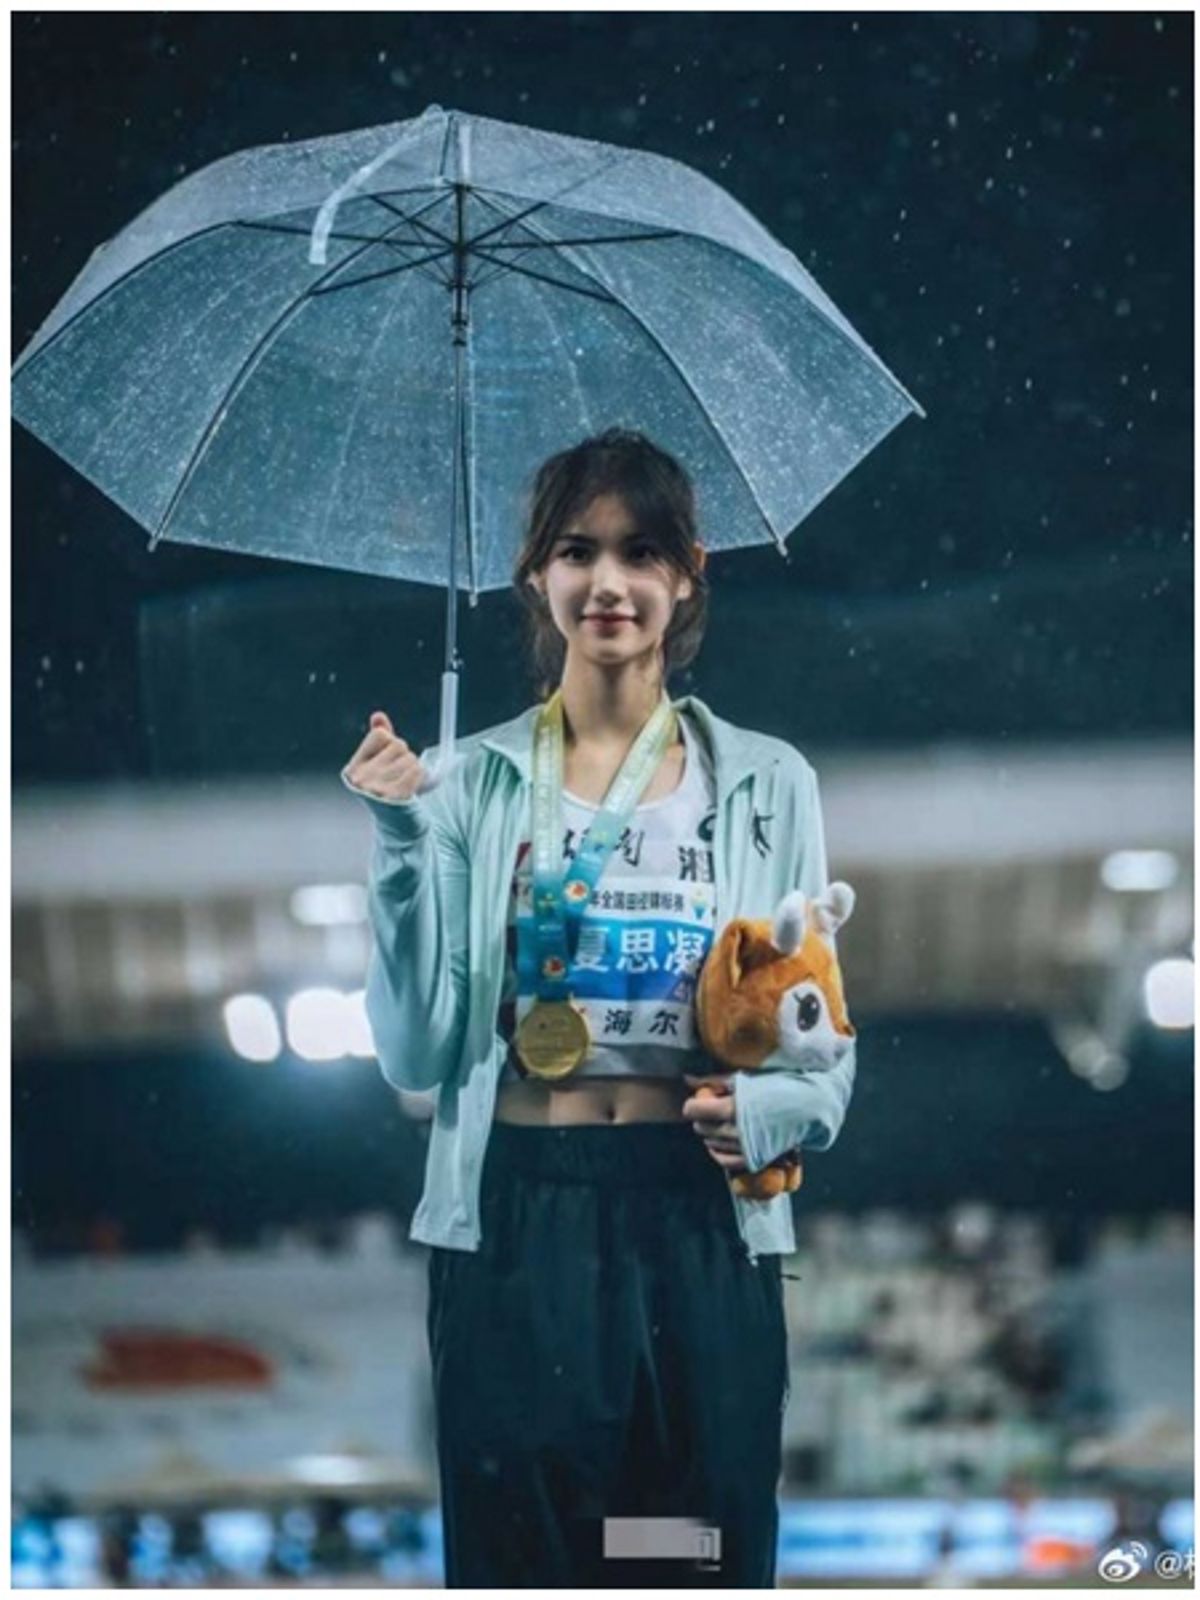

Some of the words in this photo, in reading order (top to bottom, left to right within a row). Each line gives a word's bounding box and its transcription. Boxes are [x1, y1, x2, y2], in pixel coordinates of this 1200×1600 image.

[571, 925, 706, 979] 夏思凝
[604, 1007, 680, 1036] 海尔
